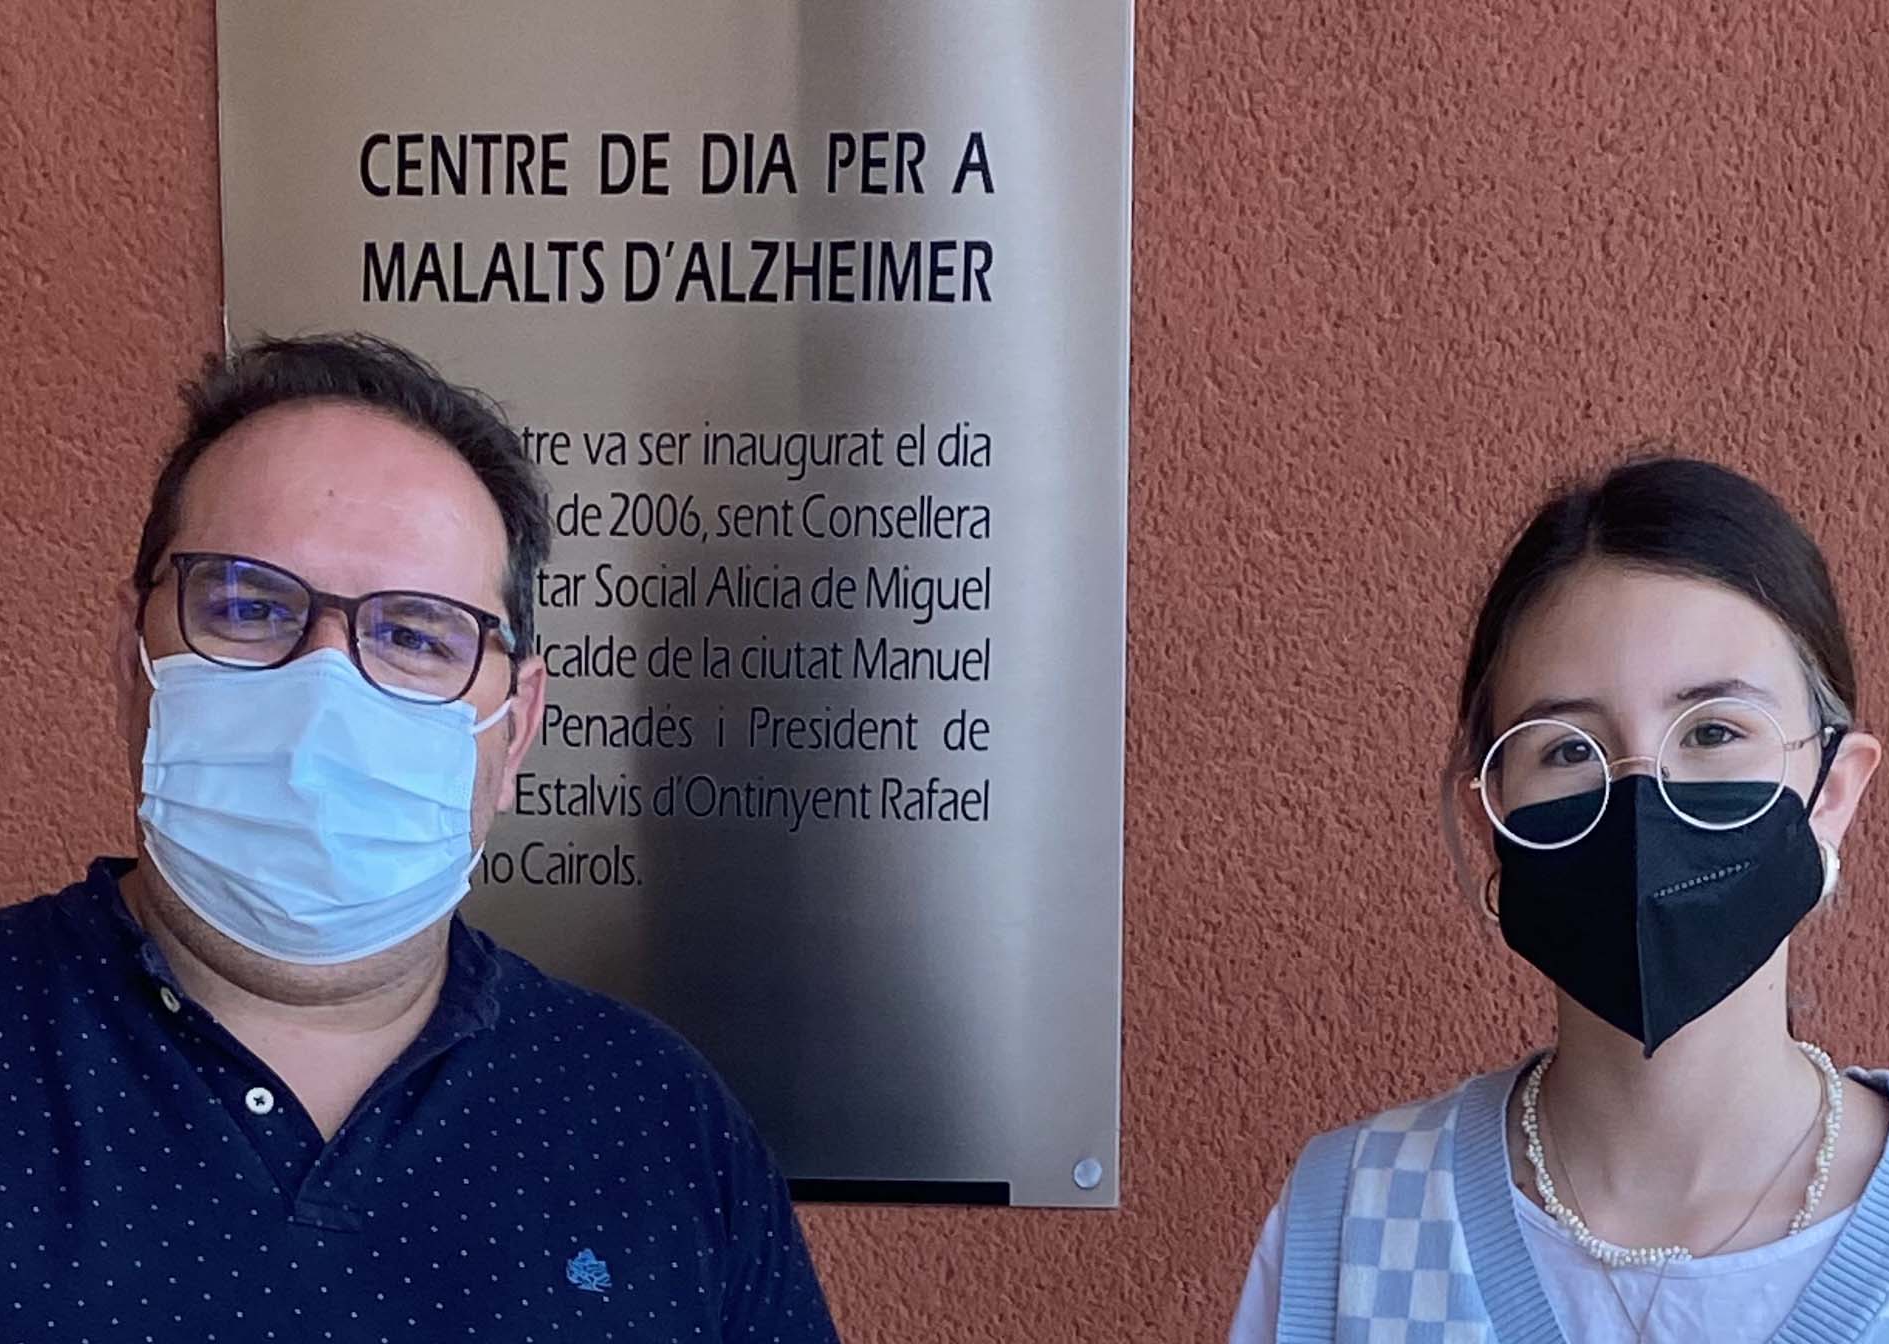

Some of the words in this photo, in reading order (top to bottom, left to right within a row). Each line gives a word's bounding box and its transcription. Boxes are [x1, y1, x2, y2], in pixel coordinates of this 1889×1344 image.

[359, 132, 568, 197] CENTRE
[600, 133, 670, 196] DE
[702, 132, 797, 195] DIA
[828, 132, 927, 194] PER
[953, 132, 995, 194] A
[362, 241, 605, 303] MALALTS
[625, 240, 993, 303] D'ALZHEIMER
[522, 426, 571, 466] tre
[583, 432, 626, 466] va
[638, 432, 691, 465] ser
[703, 421, 884, 481] inaugurat
[896, 423, 925, 467] el
[937, 422, 991, 467] dia
[556, 493, 602, 537] de
[610, 492, 708, 543] 2006,
[716, 500, 793, 537] sent
[803, 494, 990, 539] Consellera
[595, 563, 696, 608] Social
[705, 564, 800, 609] Alicia
[811, 567, 856, 609] de
[866, 565, 990, 625] Miguel
[536, 634, 637, 678] calde
[648, 636, 692, 678] de
[703, 636, 730, 679] la
[741, 635, 843, 680] ciutat
[853, 637, 990, 681] Manuel
[717, 704, 725, 748] i
[750, 706, 918, 751] President
[943, 709, 990, 751] de
[515, 773, 642, 817] Estalvis
[653, 775, 872, 833] d'Ontinyent
[881, 777, 990, 822] Rafael
[521, 841, 643, 886] Cairols.
